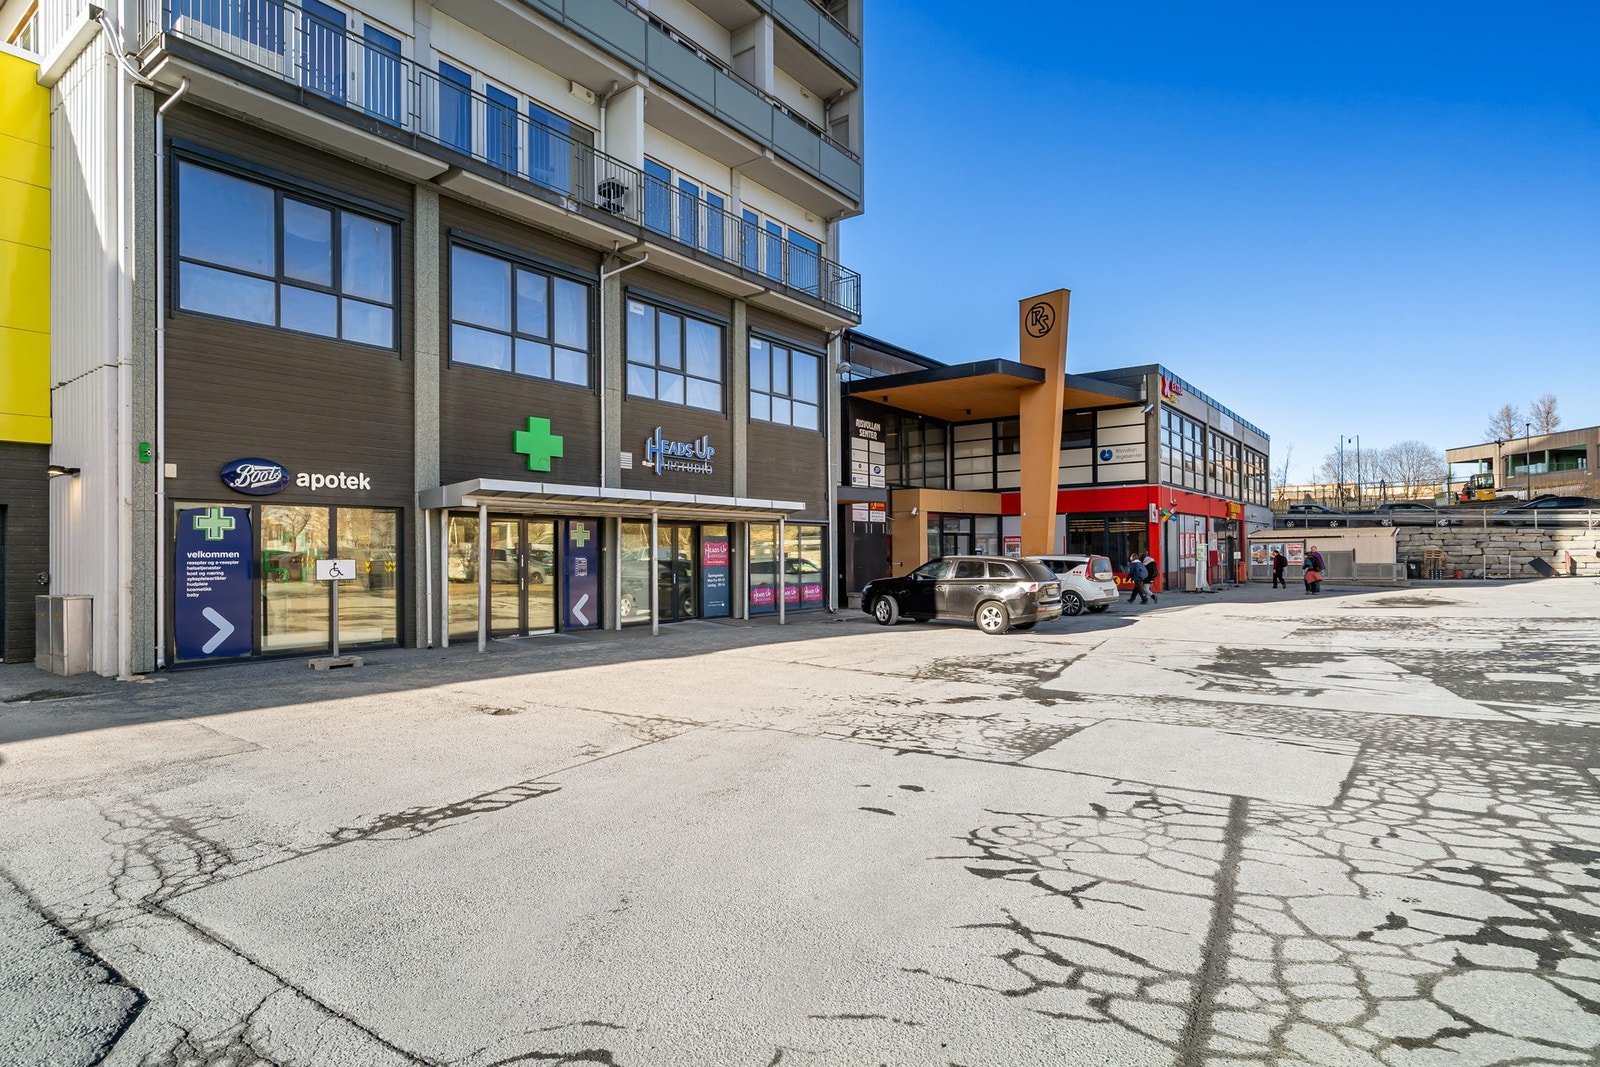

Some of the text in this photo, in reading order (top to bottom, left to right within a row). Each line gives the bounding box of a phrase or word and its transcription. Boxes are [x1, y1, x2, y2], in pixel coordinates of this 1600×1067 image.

[855, 418, 881, 432] RISVOLLAN
[859, 429, 878, 441] SENTER
[229, 463, 372, 491] Boots apotek
[186, 550, 240, 559] velkommen
